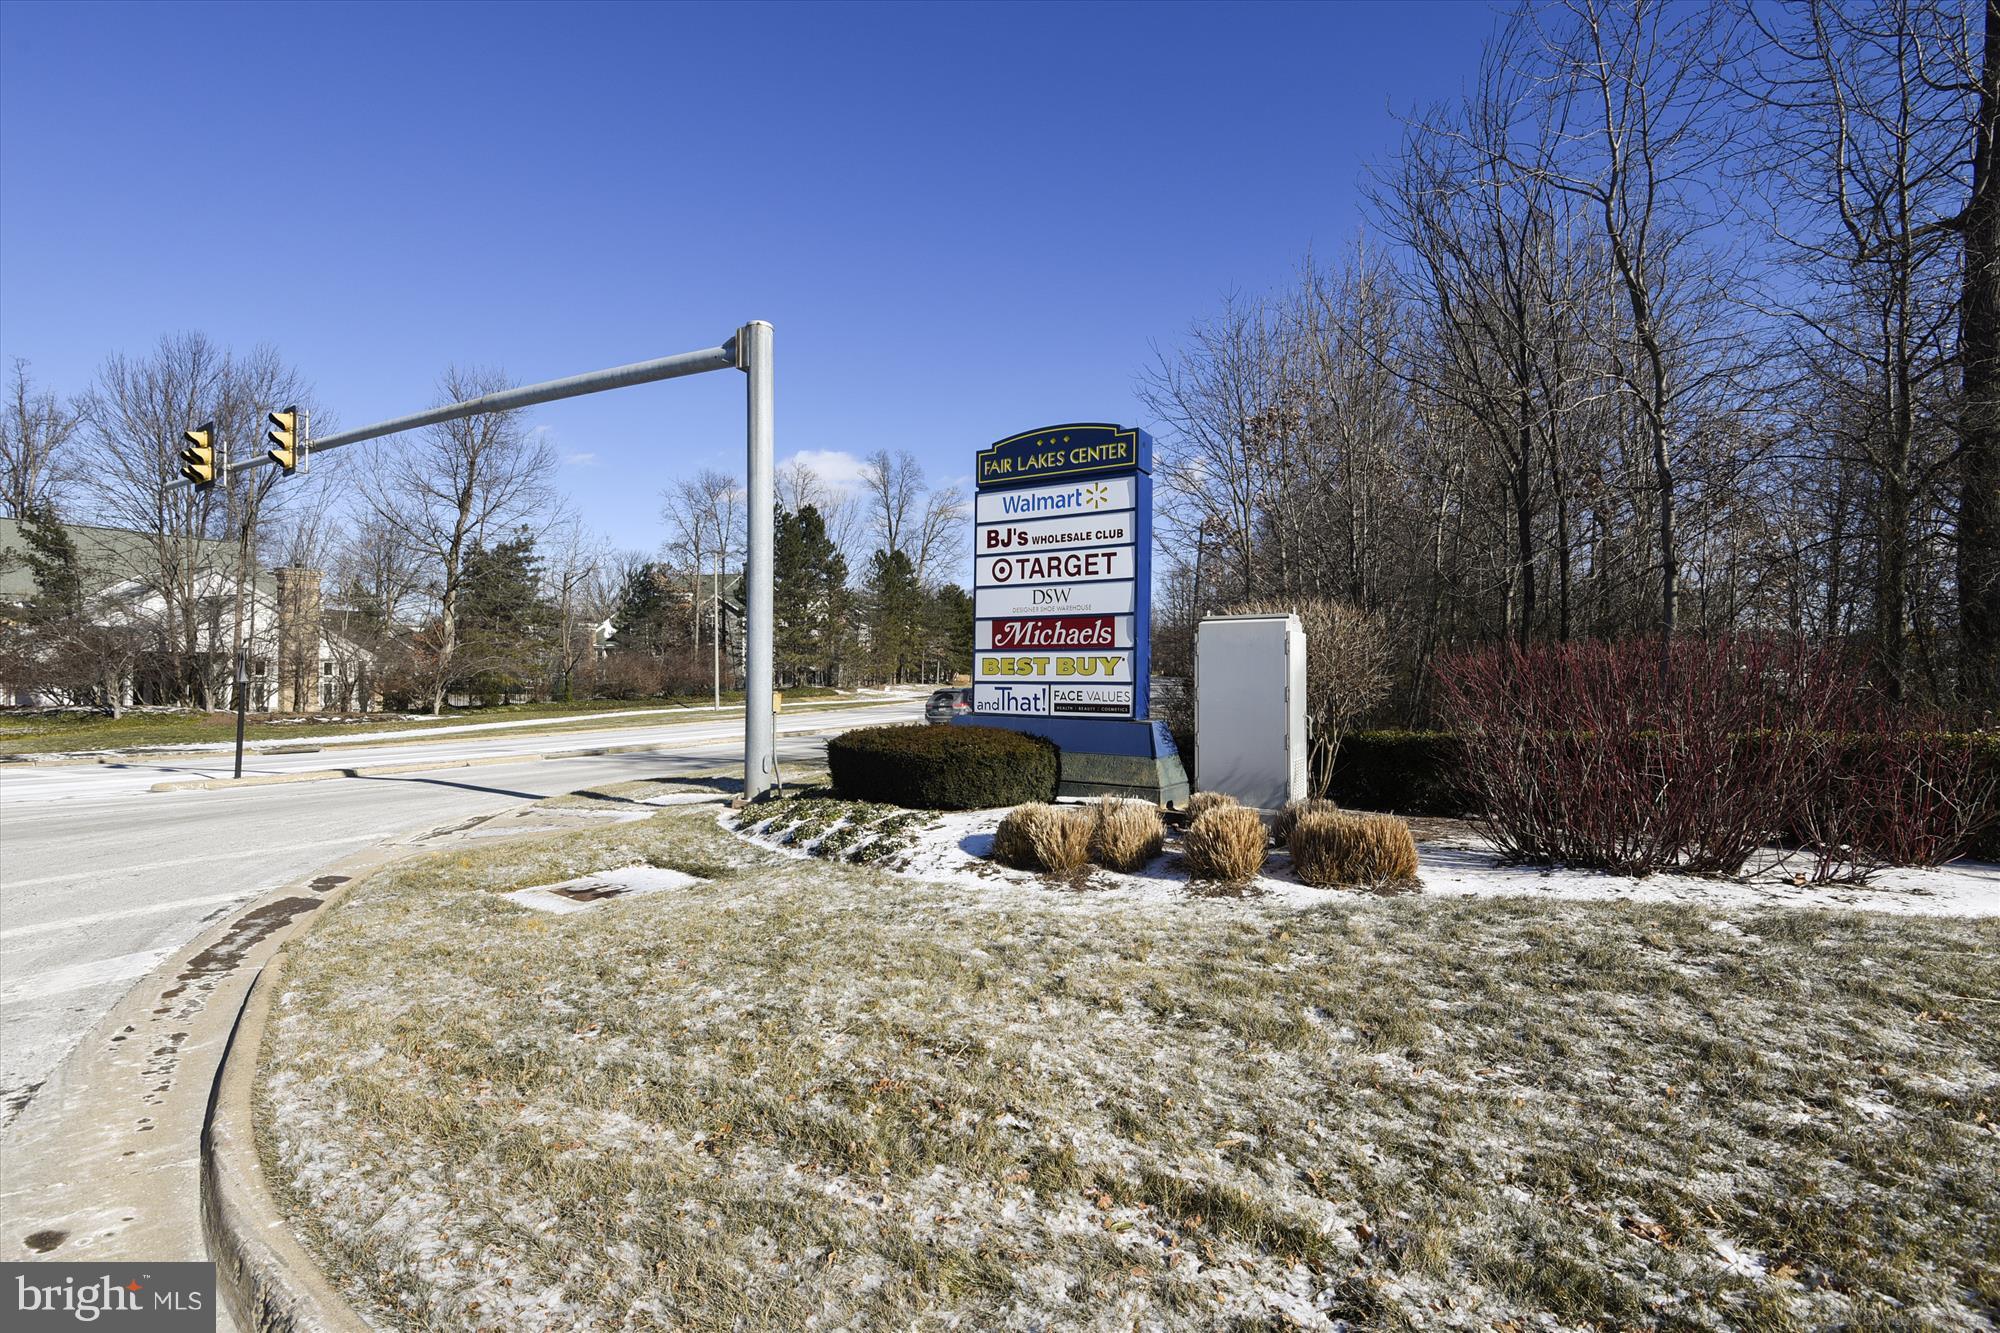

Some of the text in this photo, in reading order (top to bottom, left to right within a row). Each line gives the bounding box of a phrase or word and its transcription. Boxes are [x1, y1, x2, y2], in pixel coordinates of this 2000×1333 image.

[984, 442, 1127, 475] FAIR LAKES CENTER
[1002, 488, 1082, 514] Walmart
[986, 528, 1124, 548] BJ's WHOLESALE CLUB
[1016, 552, 1117, 579] TARGET
[1032, 588, 1071, 605] DSW
[994, 620, 1112, 647] Michaels
[982, 656, 1121, 676] BEST BUY
[1054, 690, 1131, 702] FACE VALUES
